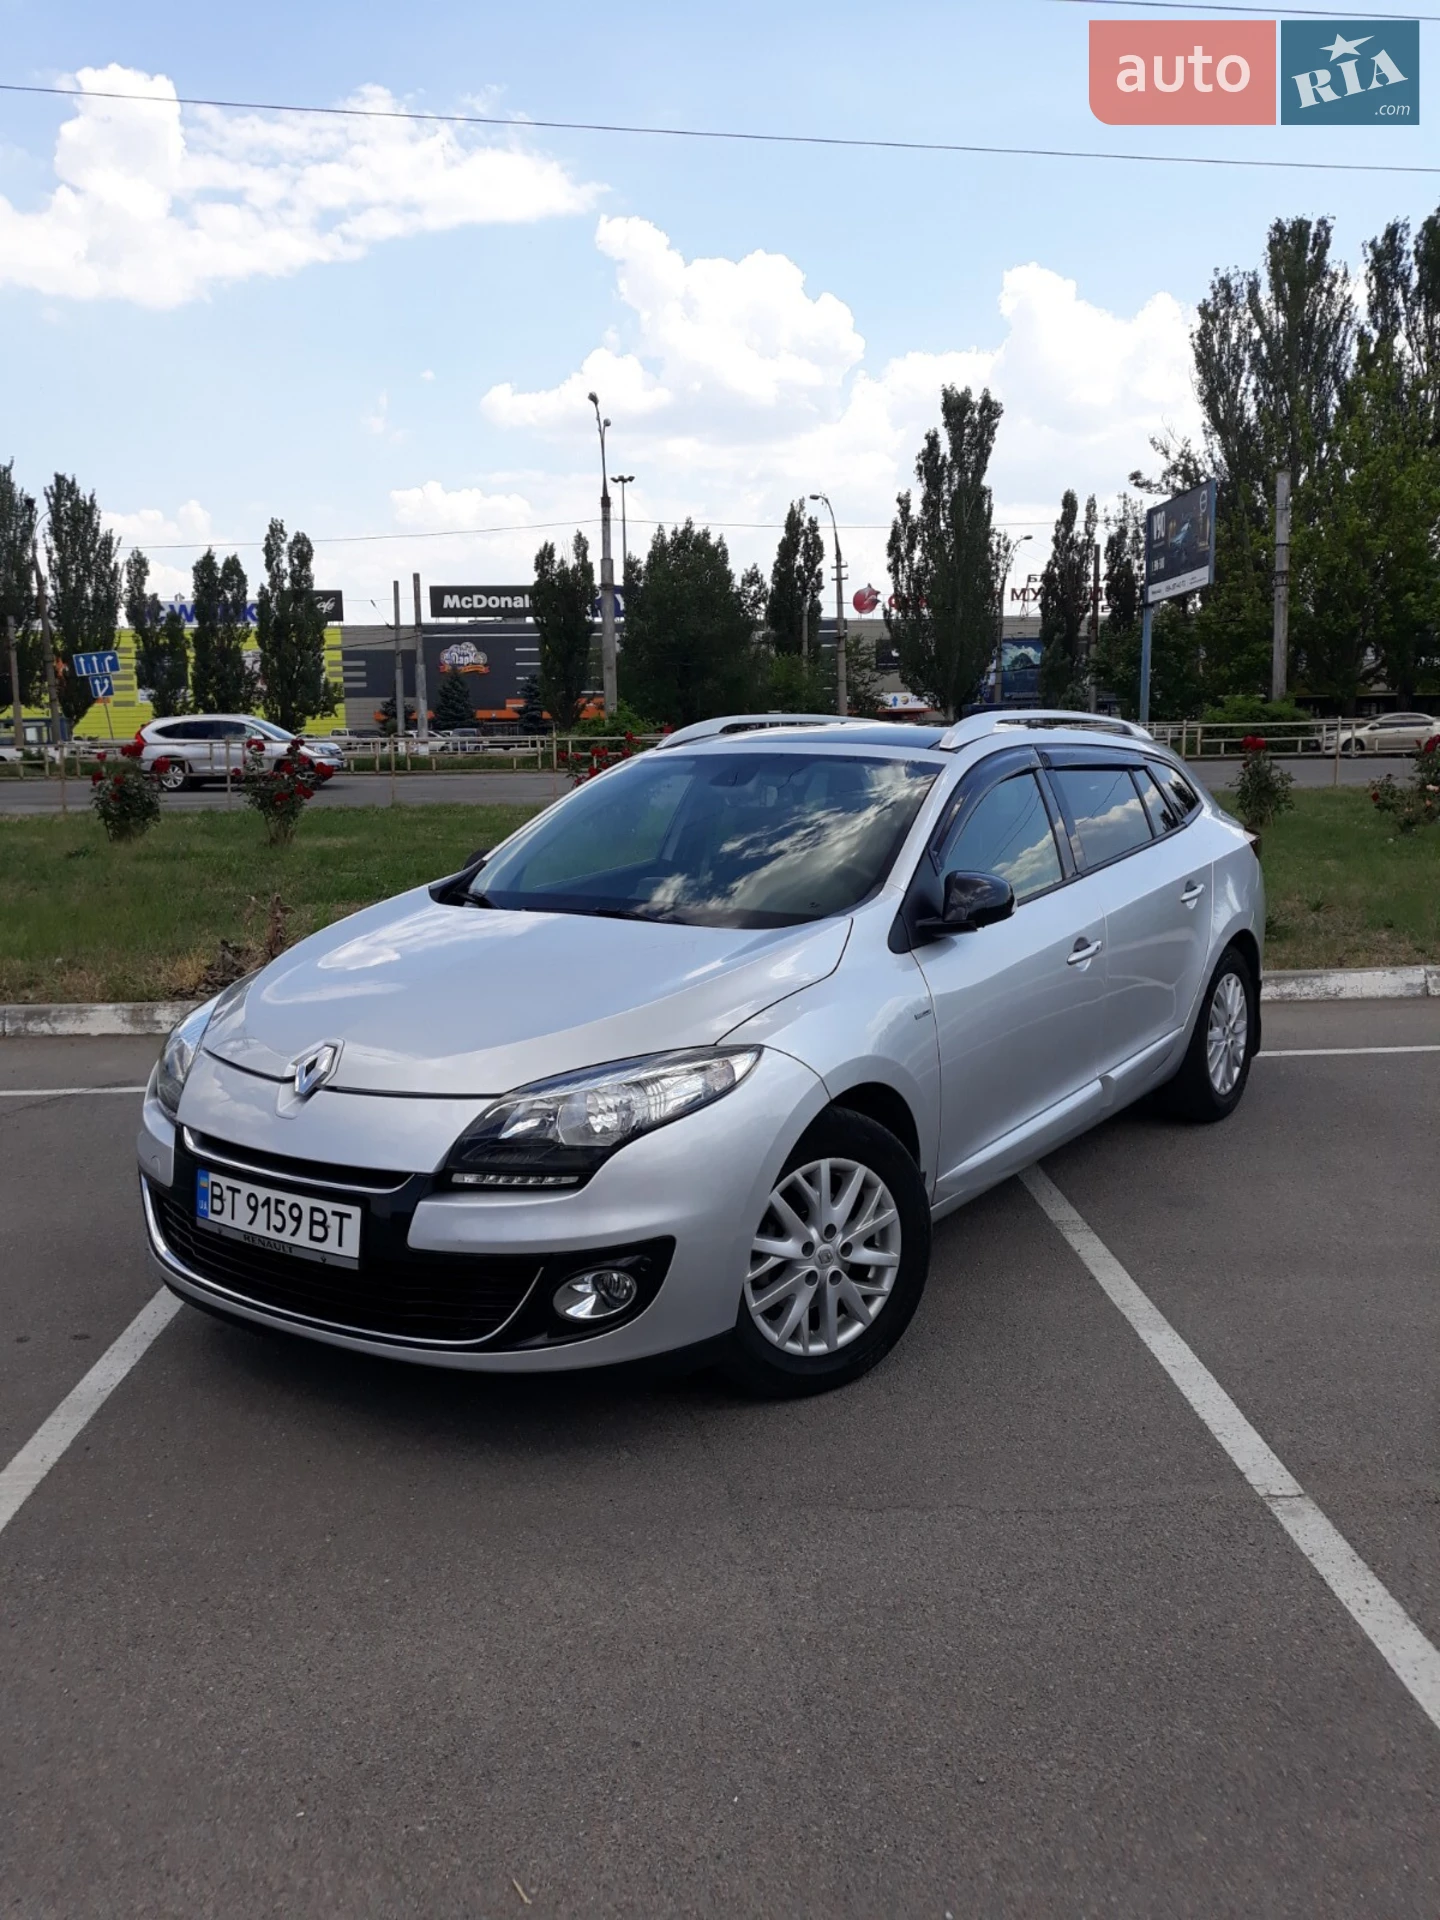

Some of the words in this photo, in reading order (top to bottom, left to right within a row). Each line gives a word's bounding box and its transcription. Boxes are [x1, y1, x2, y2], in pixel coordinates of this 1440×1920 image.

[443, 594, 535, 609] McDonal
[210, 1180, 242, 1220] BT
[246, 1192, 303, 1237] 9159
[309, 1206, 352, 1248] BT
[243, 1234, 294, 1254] RENAULT
